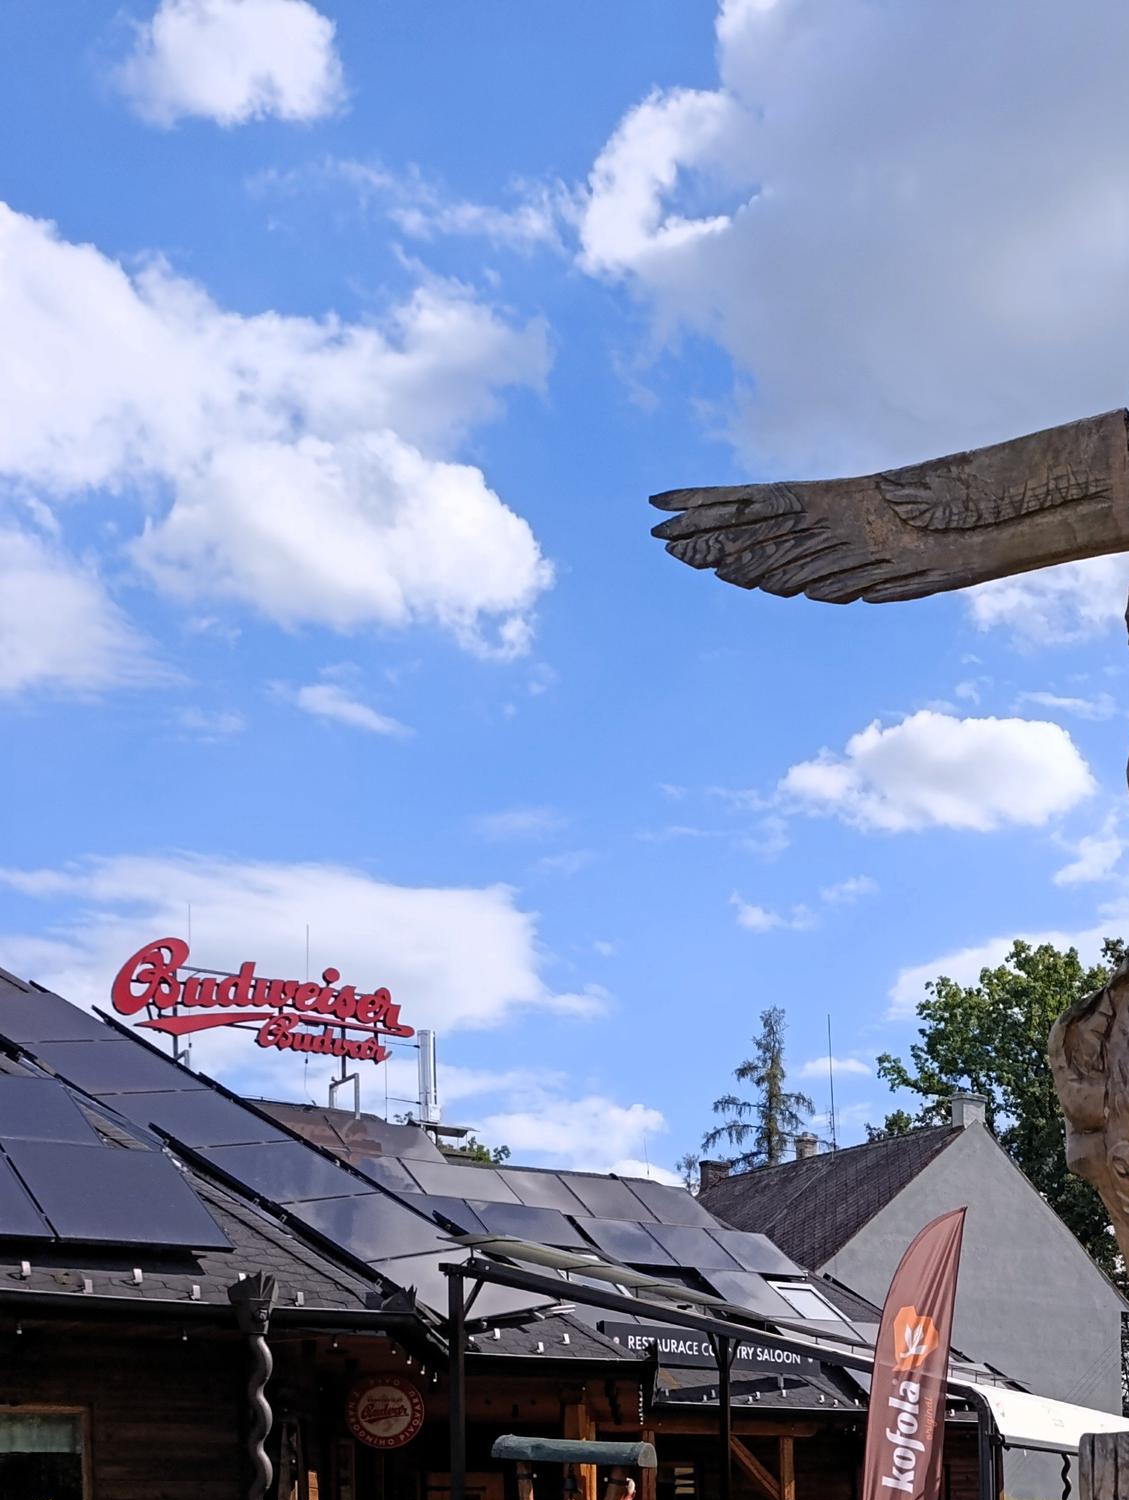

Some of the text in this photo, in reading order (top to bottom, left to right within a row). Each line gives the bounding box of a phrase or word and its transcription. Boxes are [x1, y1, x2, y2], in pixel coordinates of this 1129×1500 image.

[111, 937, 403, 1031] Budweiser
[254, 1012, 393, 1064] Budvar
[757, 1348, 801, 1364] SALOON
[881, 1380, 925, 1494] kofola
